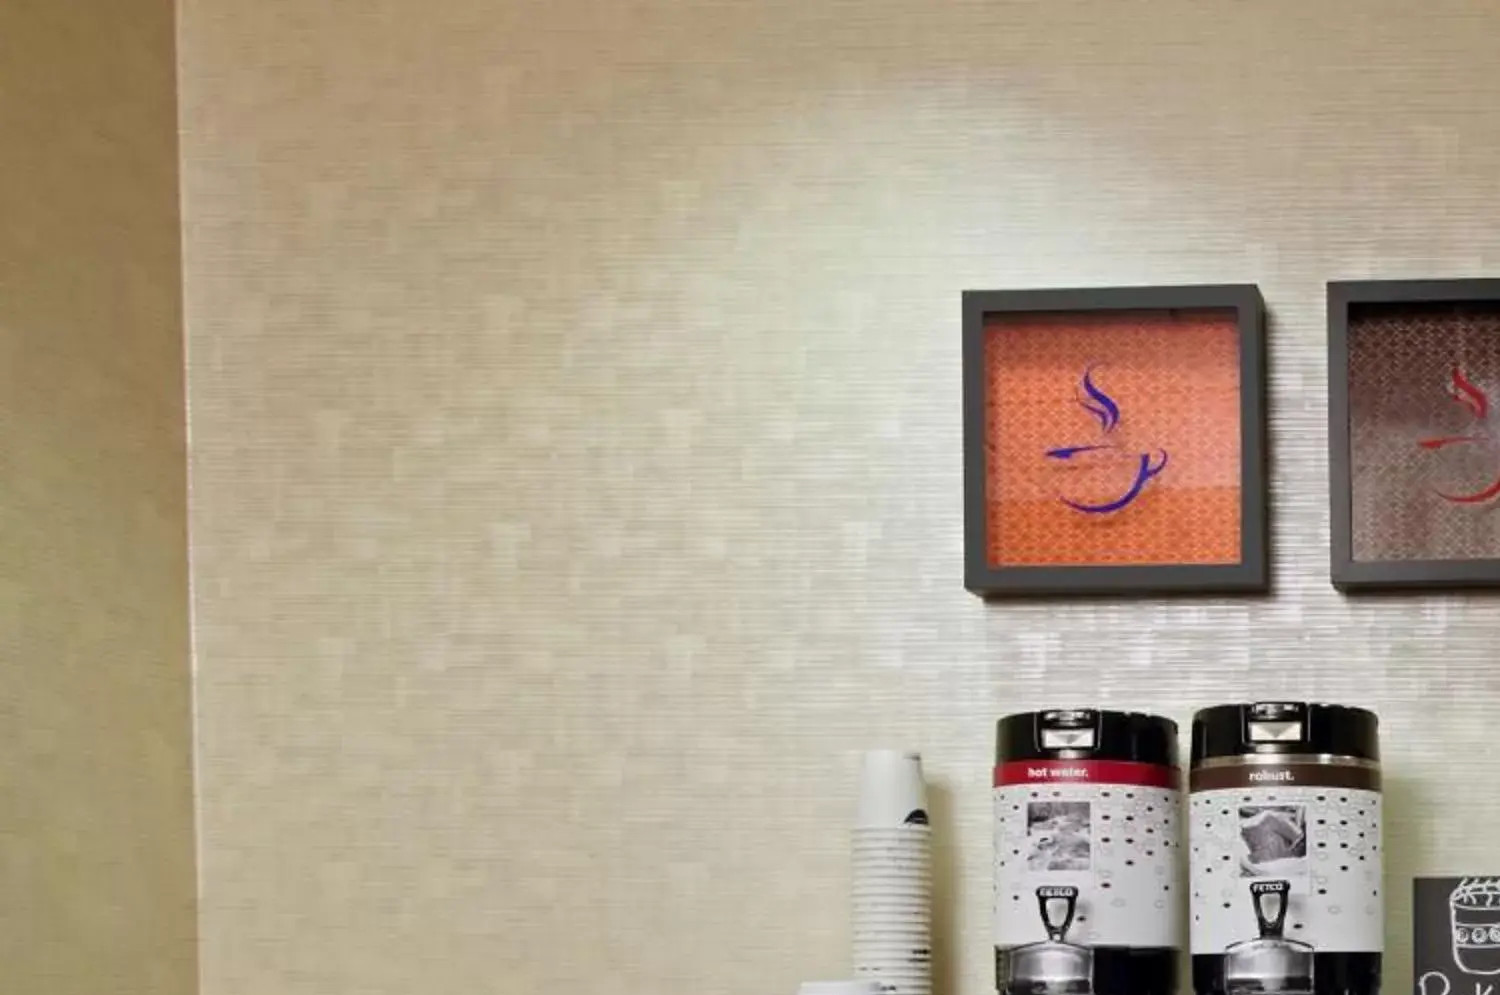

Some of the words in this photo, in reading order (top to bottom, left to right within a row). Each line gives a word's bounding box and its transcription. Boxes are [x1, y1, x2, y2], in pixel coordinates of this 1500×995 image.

[1027, 767, 1048, 778] hot
[1248, 769, 1295, 782] robust.
[1252, 882, 1284, 893] FETCO
